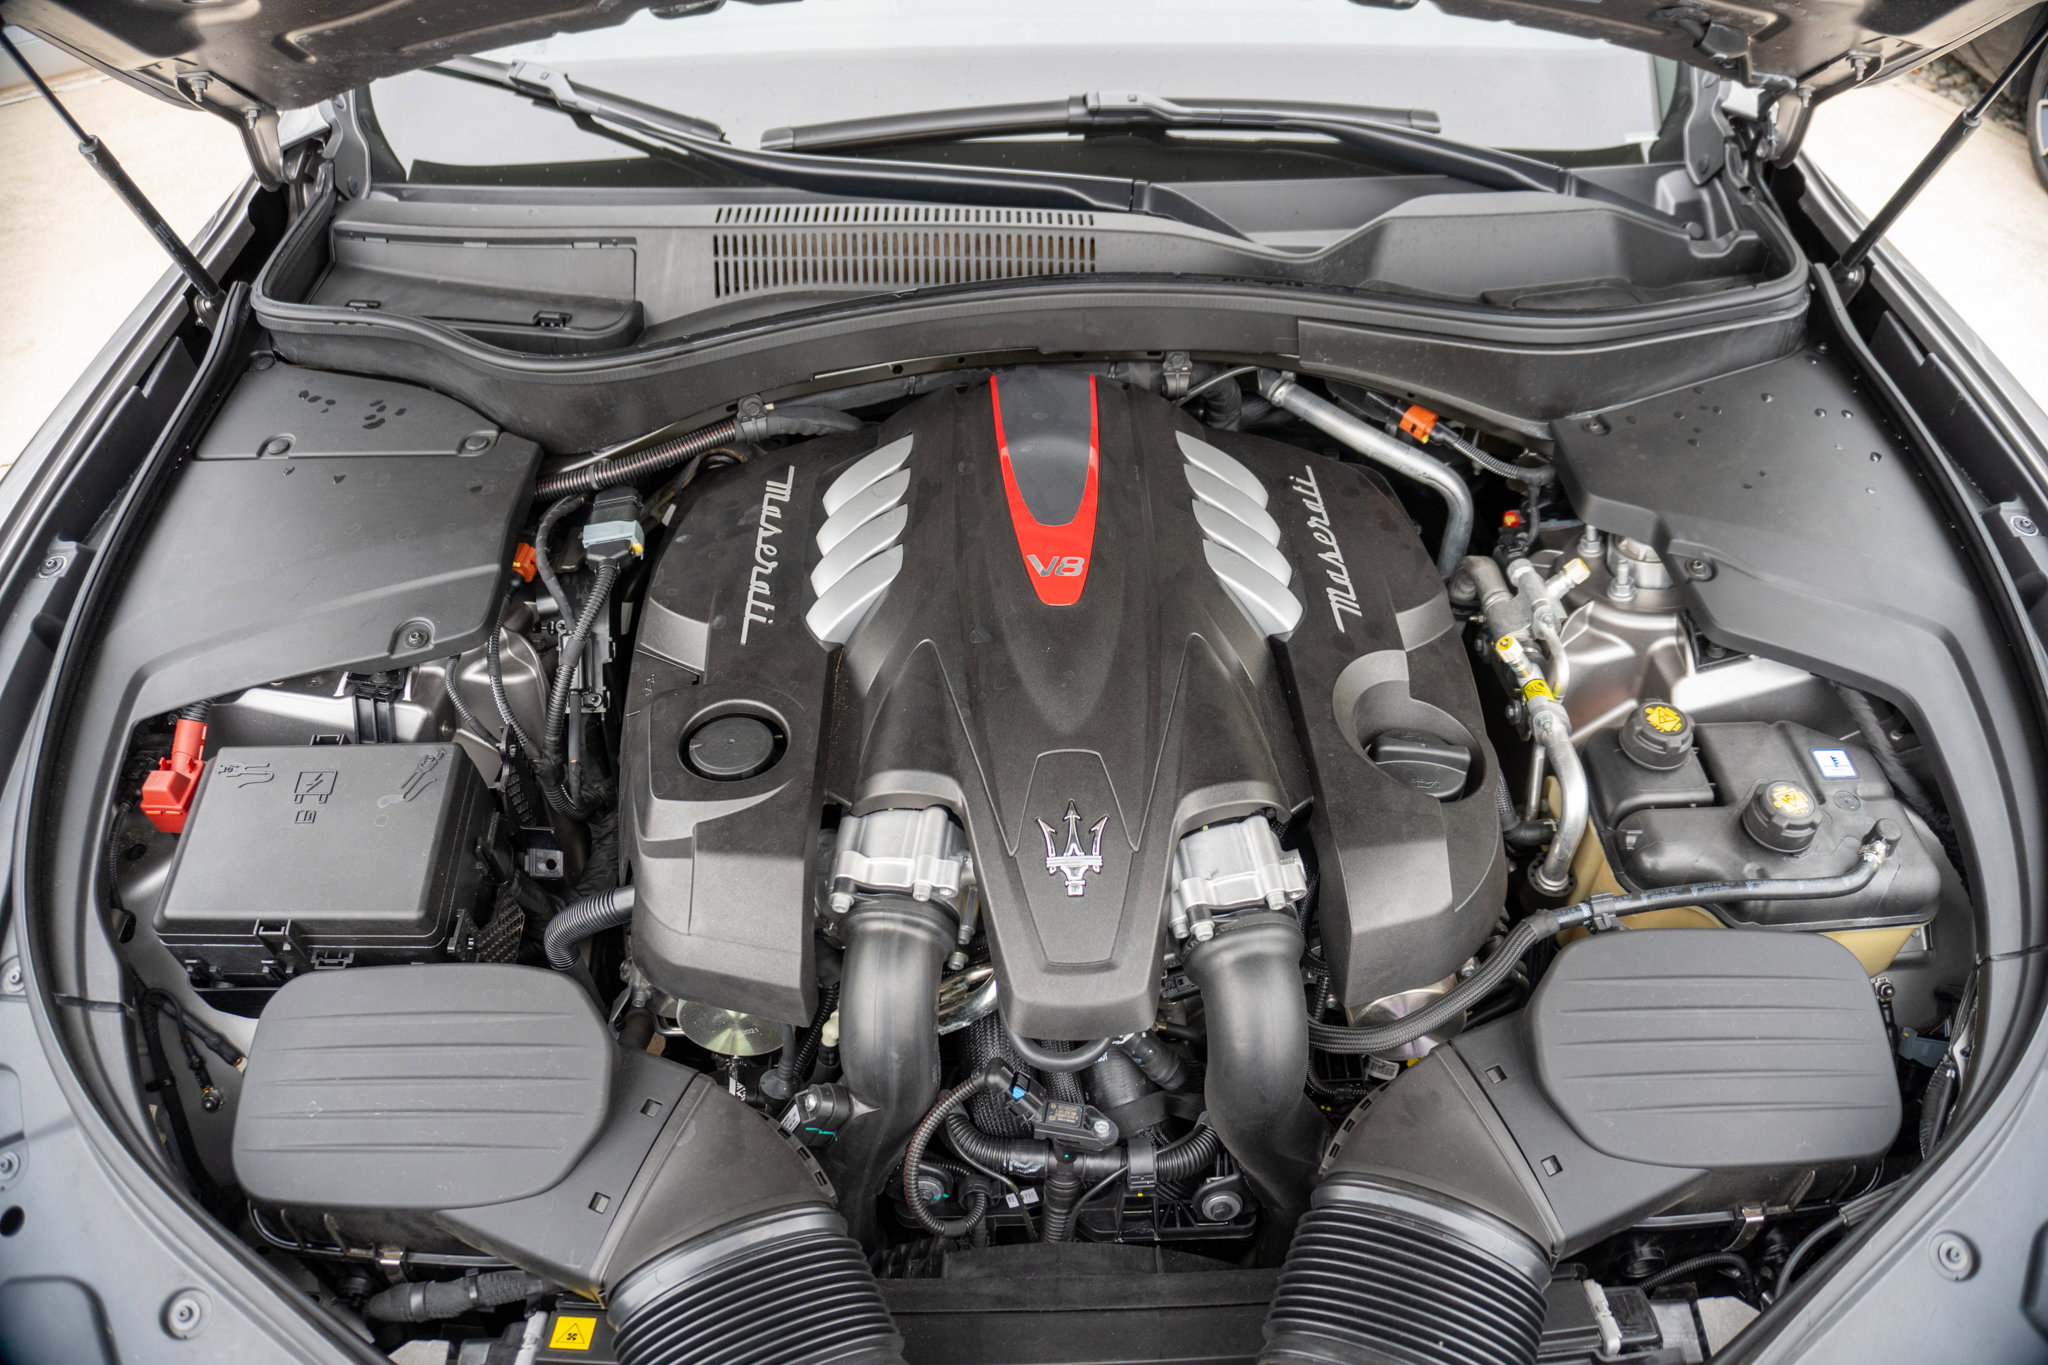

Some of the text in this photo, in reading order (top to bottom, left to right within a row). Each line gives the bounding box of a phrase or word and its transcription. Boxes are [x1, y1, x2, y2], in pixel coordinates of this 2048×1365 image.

[740, 465, 795, 645] Maserati
[1026, 554, 1085, 577] V8
[1289, 464, 1363, 634] Maserati
